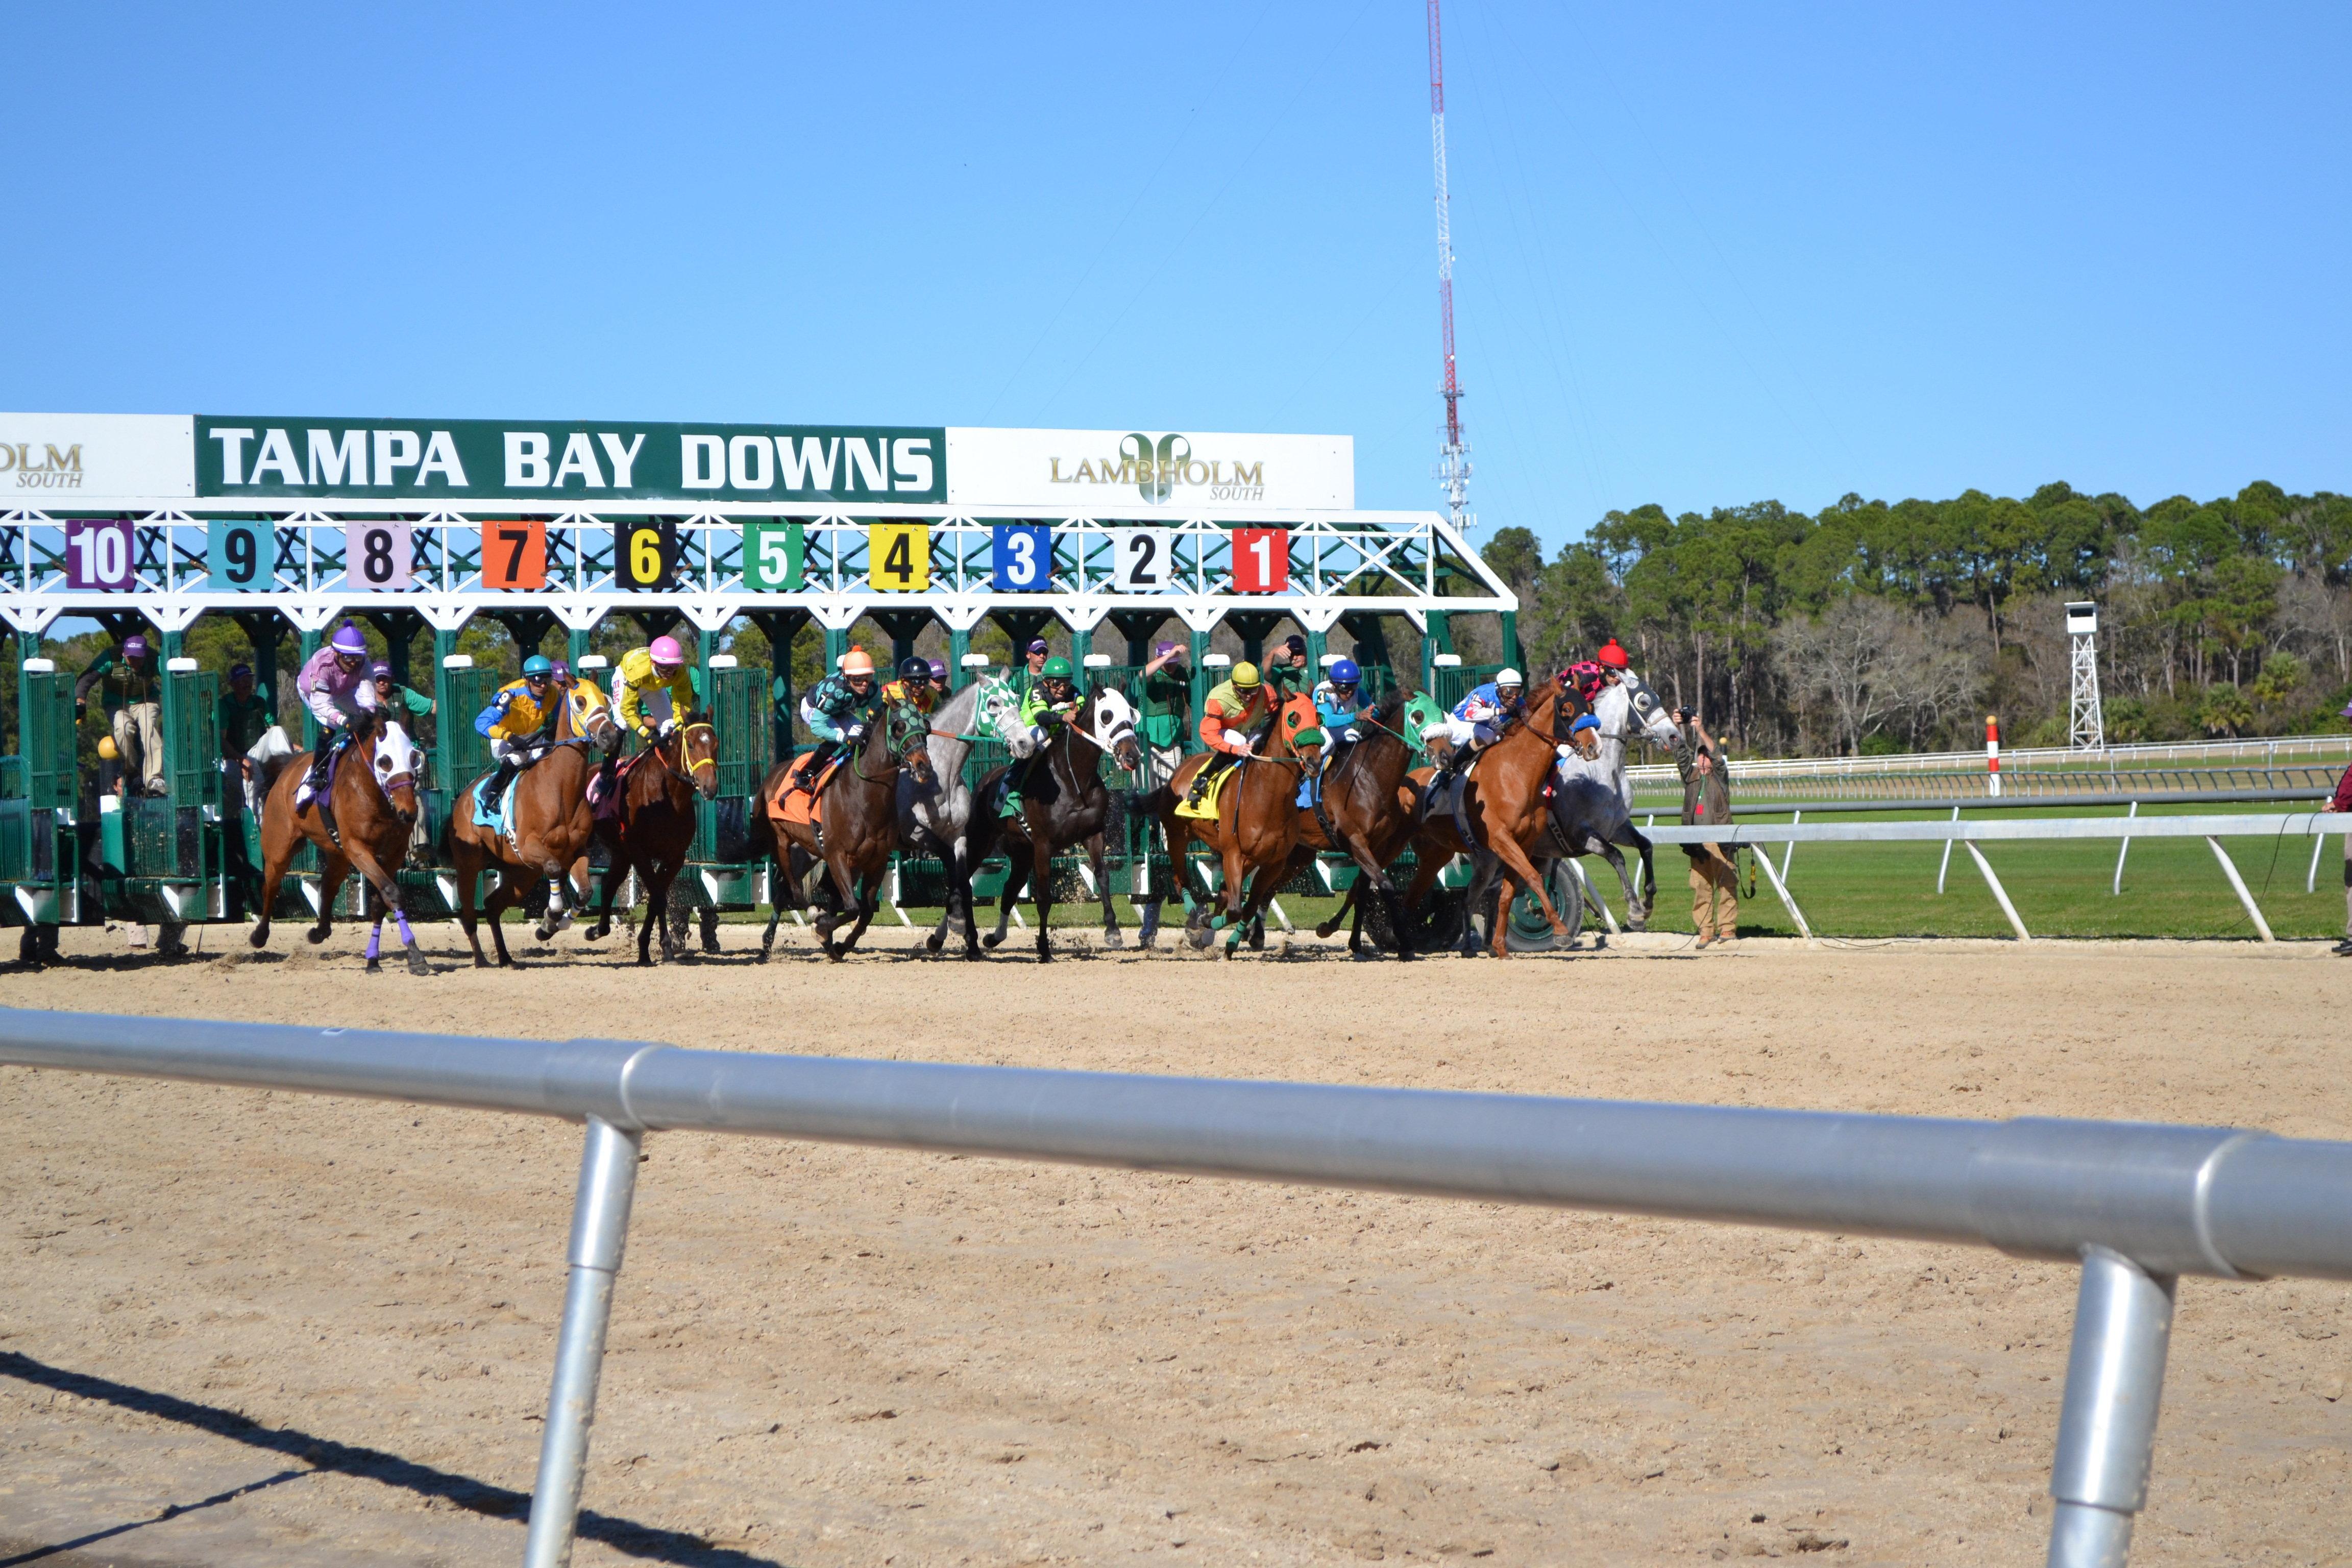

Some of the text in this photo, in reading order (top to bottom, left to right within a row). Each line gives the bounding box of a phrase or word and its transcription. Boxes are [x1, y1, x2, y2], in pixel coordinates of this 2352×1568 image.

[16, 472, 83, 488] SOUTH
[210, 428, 933, 491] TAMPA BAY DOWNS
[1050, 457, 1264, 486] LAMBHOLM
[1210, 486, 1264, 501] SOUTH
[70, 527, 126, 583] 10
[225, 529, 256, 583] 9
[364, 529, 394, 583] 8
[498, 530, 528, 582] 7
[630, 529, 660, 583] 6
[758, 531, 788, 584] 5
[884, 533, 914, 583] 4
[1007, 532, 1036, 585] 3
[1129, 534, 1156, 583] 2
[1250, 535, 1270, 586] 1
[498, 692, 509, 704] 9
[817, 694, 826, 708] 7
[1032, 689, 1041, 701] 5
[1317, 691, 1325, 703] 3
